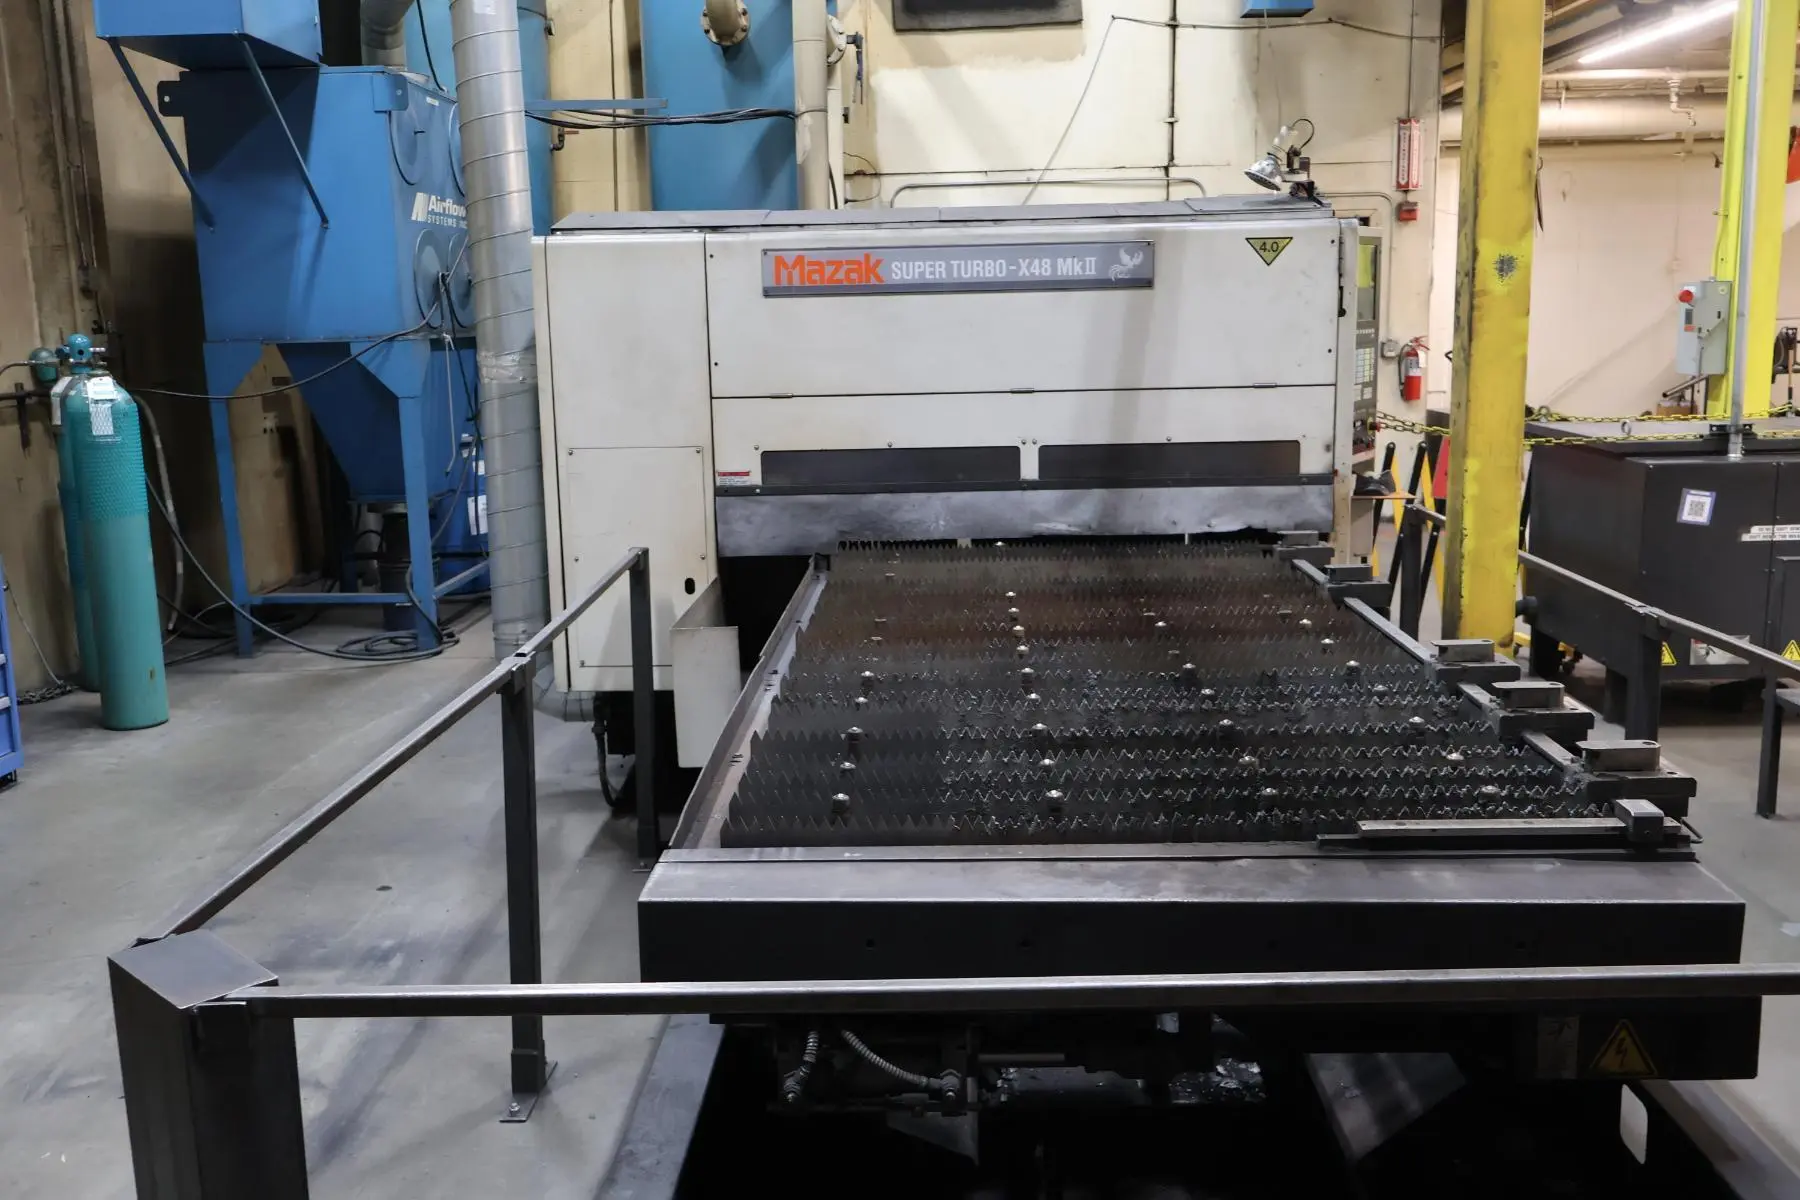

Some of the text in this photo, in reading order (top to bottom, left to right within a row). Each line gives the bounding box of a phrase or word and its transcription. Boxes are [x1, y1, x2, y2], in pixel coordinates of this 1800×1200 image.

[428, 195, 467, 218] Airflow
[427, 214, 457, 228] SYSTEMS
[1258, 241, 1279, 253] 4.0
[774, 252, 885, 286] Mazak
[891, 260, 946, 280] SUPER
